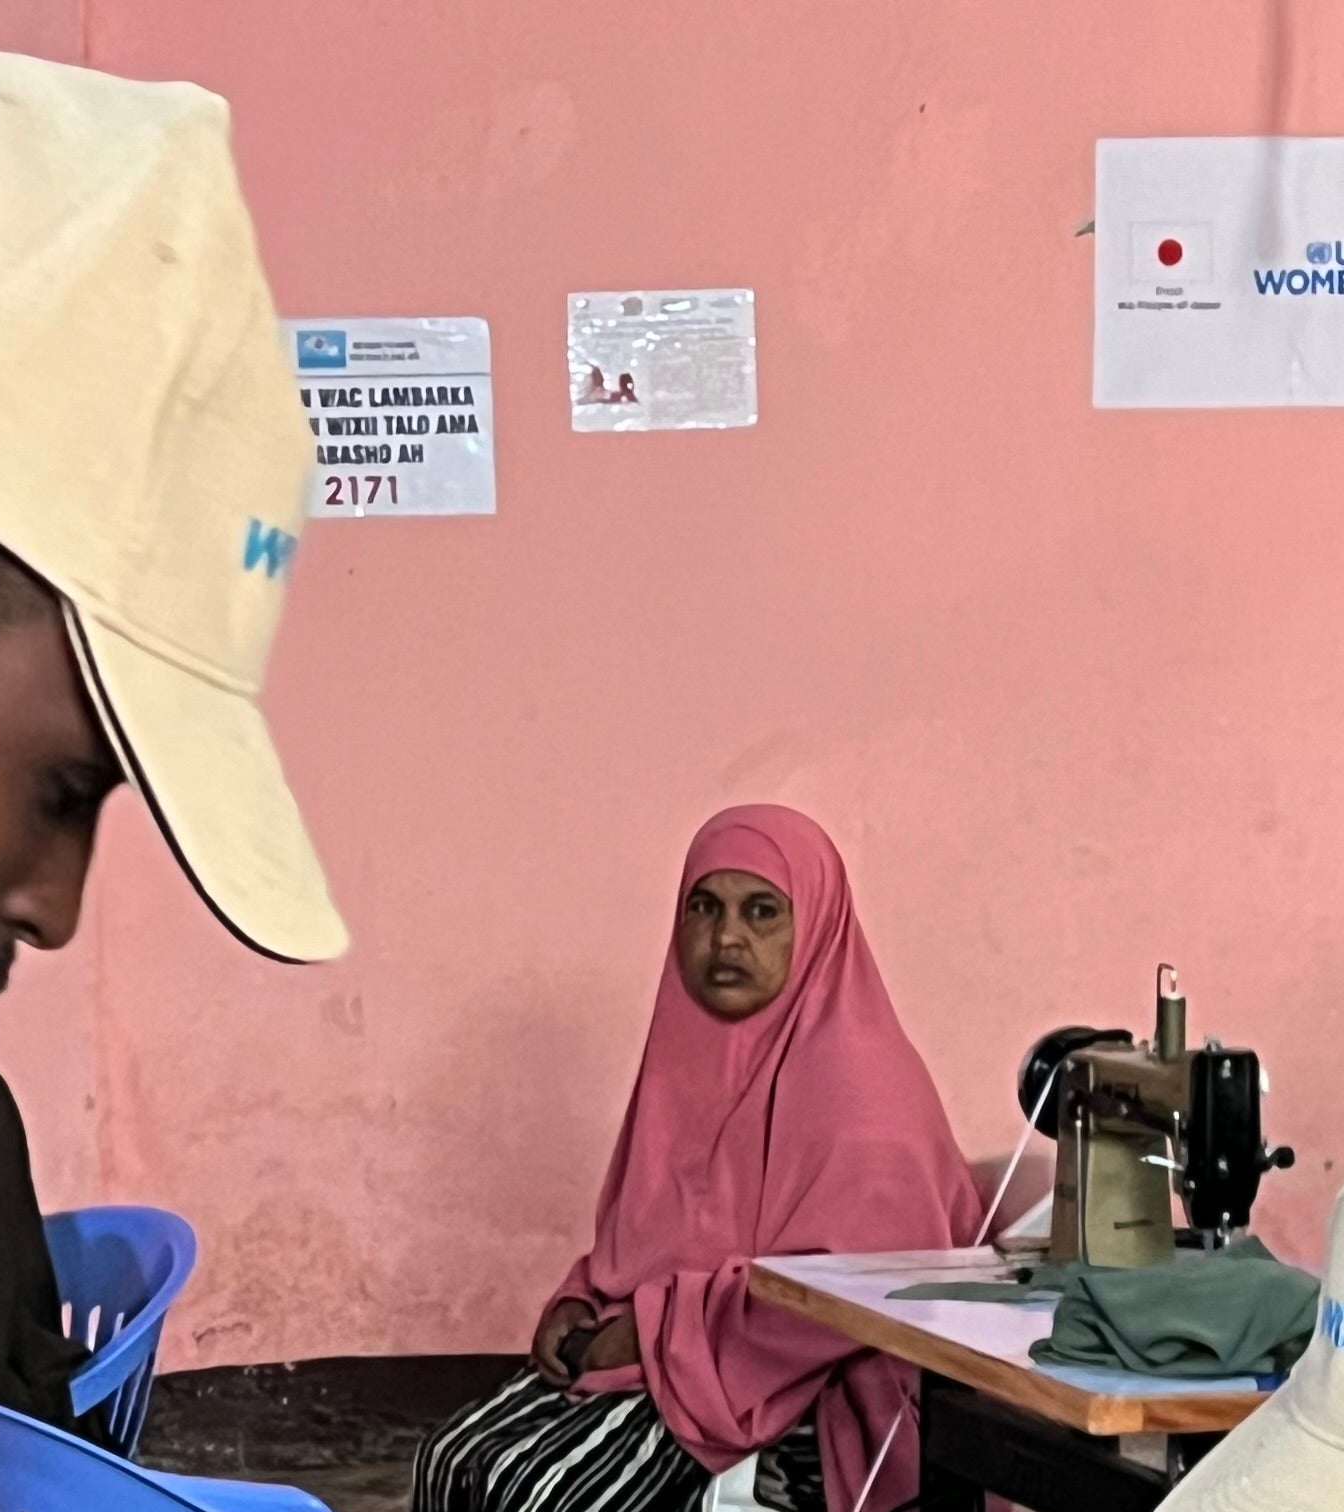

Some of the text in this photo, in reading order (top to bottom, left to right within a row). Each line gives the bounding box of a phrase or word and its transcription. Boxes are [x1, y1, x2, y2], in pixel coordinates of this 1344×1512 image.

[318, 388, 363, 408] WAC
[368, 386, 474, 407] LAMBARKA
[384, 415, 430, 436] TALO
[435, 414, 479, 434] AMA
[397, 444, 424, 463] AH
[325, 476, 398, 505] 2171
